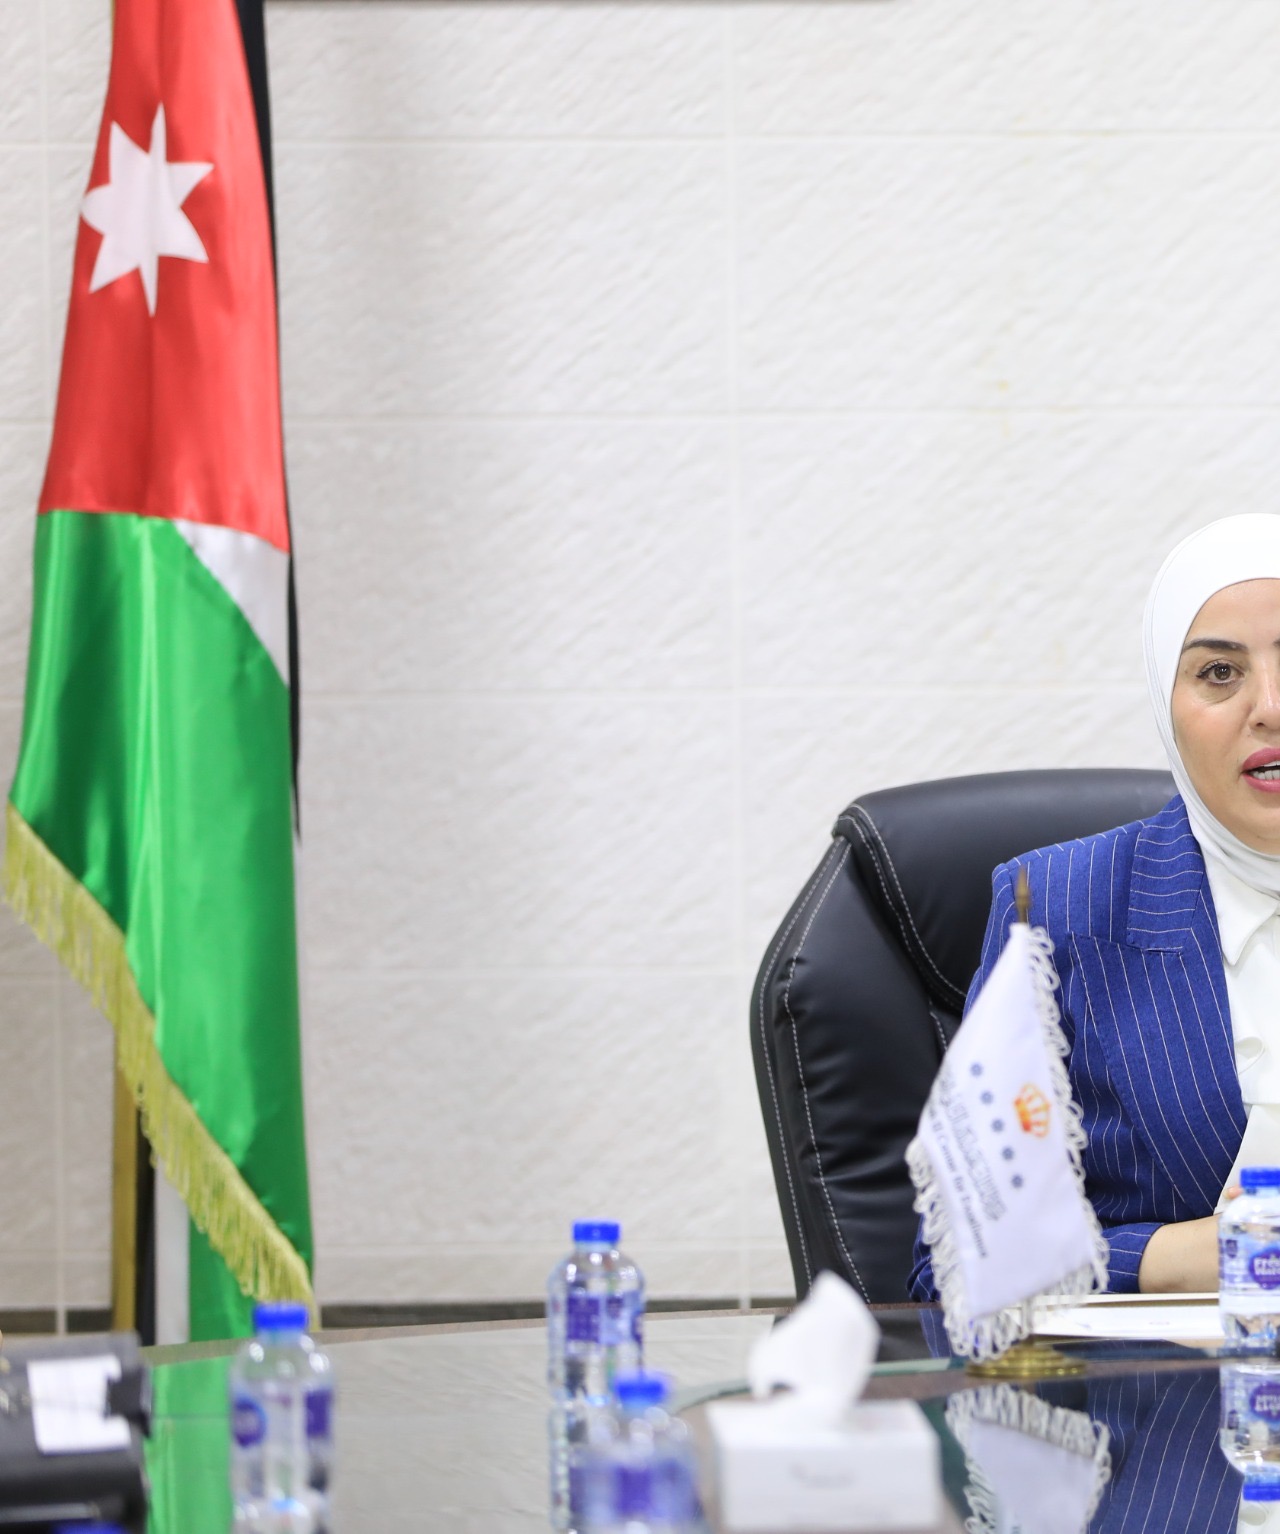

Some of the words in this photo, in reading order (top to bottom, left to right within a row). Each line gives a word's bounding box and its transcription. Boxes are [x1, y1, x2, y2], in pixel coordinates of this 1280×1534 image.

[936, 1134, 956, 1173] Center
[953, 1175, 966, 1193] for
[961, 1195, 988, 1258] Excellence
